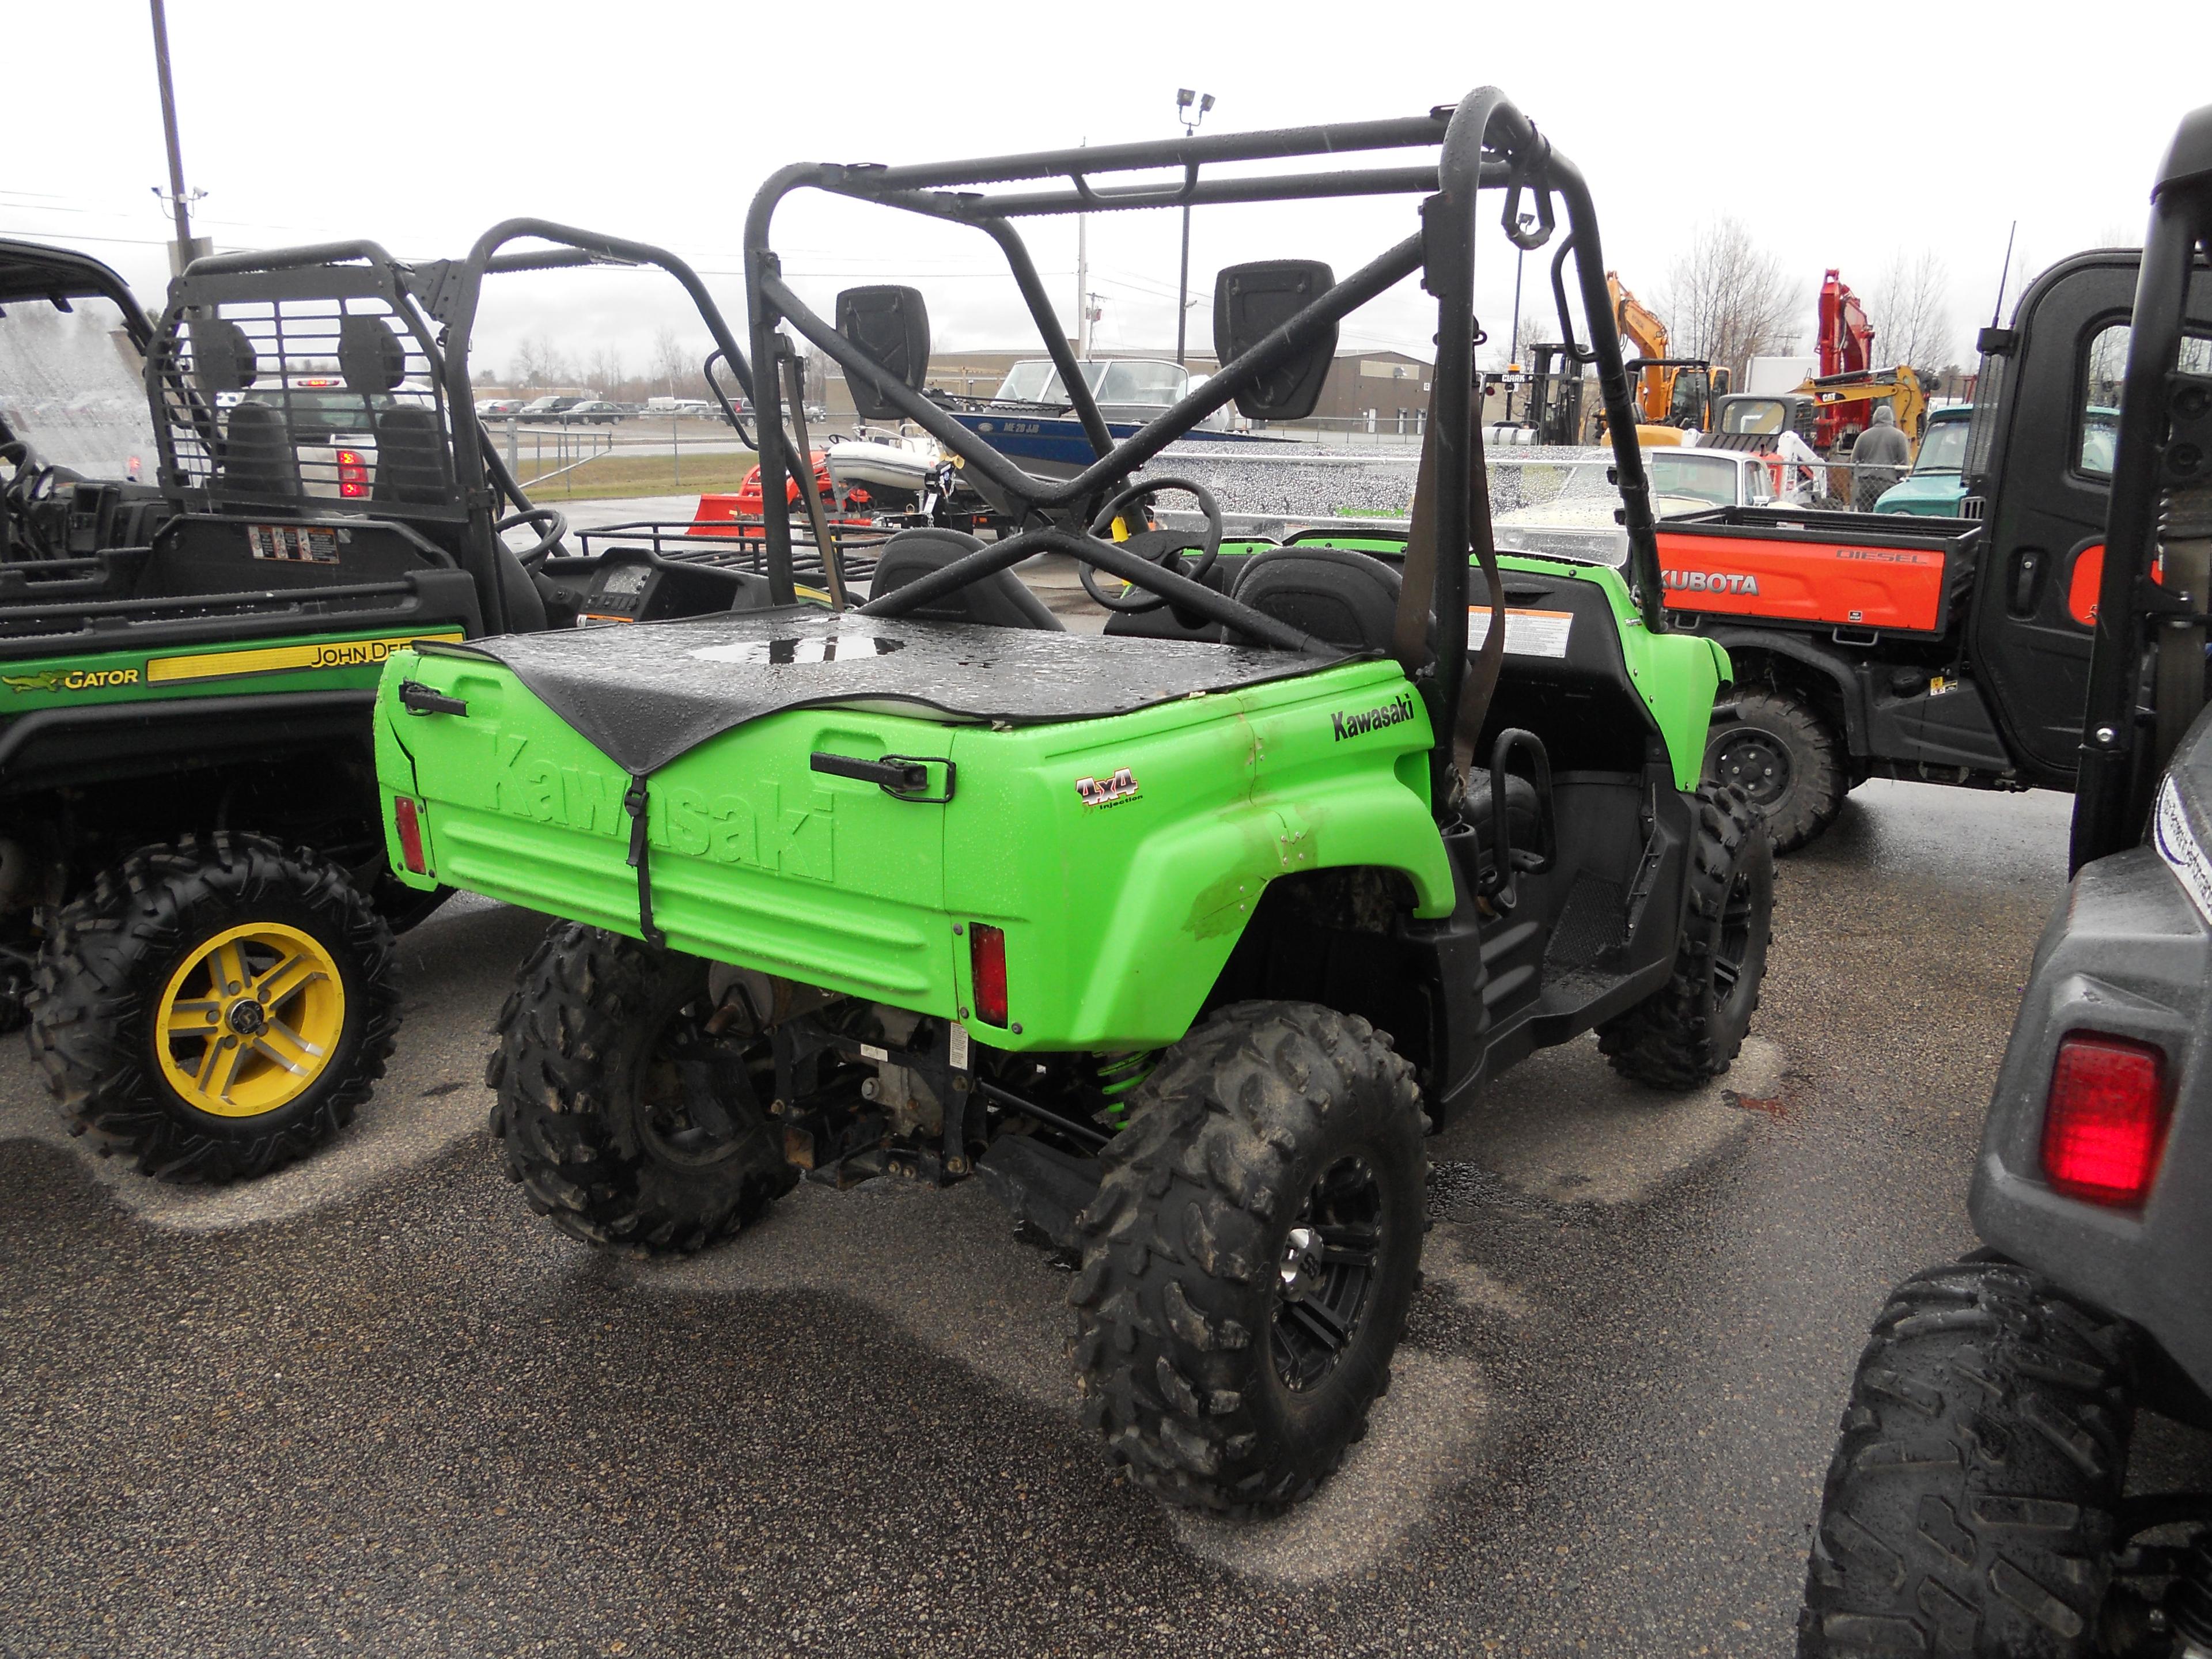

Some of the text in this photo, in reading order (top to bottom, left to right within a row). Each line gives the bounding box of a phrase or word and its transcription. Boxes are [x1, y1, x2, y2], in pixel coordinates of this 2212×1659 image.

[1823, 393, 1835, 402] CAT
[1836, 550, 1927, 565] DIESEL
[311, 646, 367, 666] JOHN
[65, 669, 138, 689] GATOR
[1331, 693, 1414, 742] Kawasaki
[1076, 767, 1139, 806] 4x4
